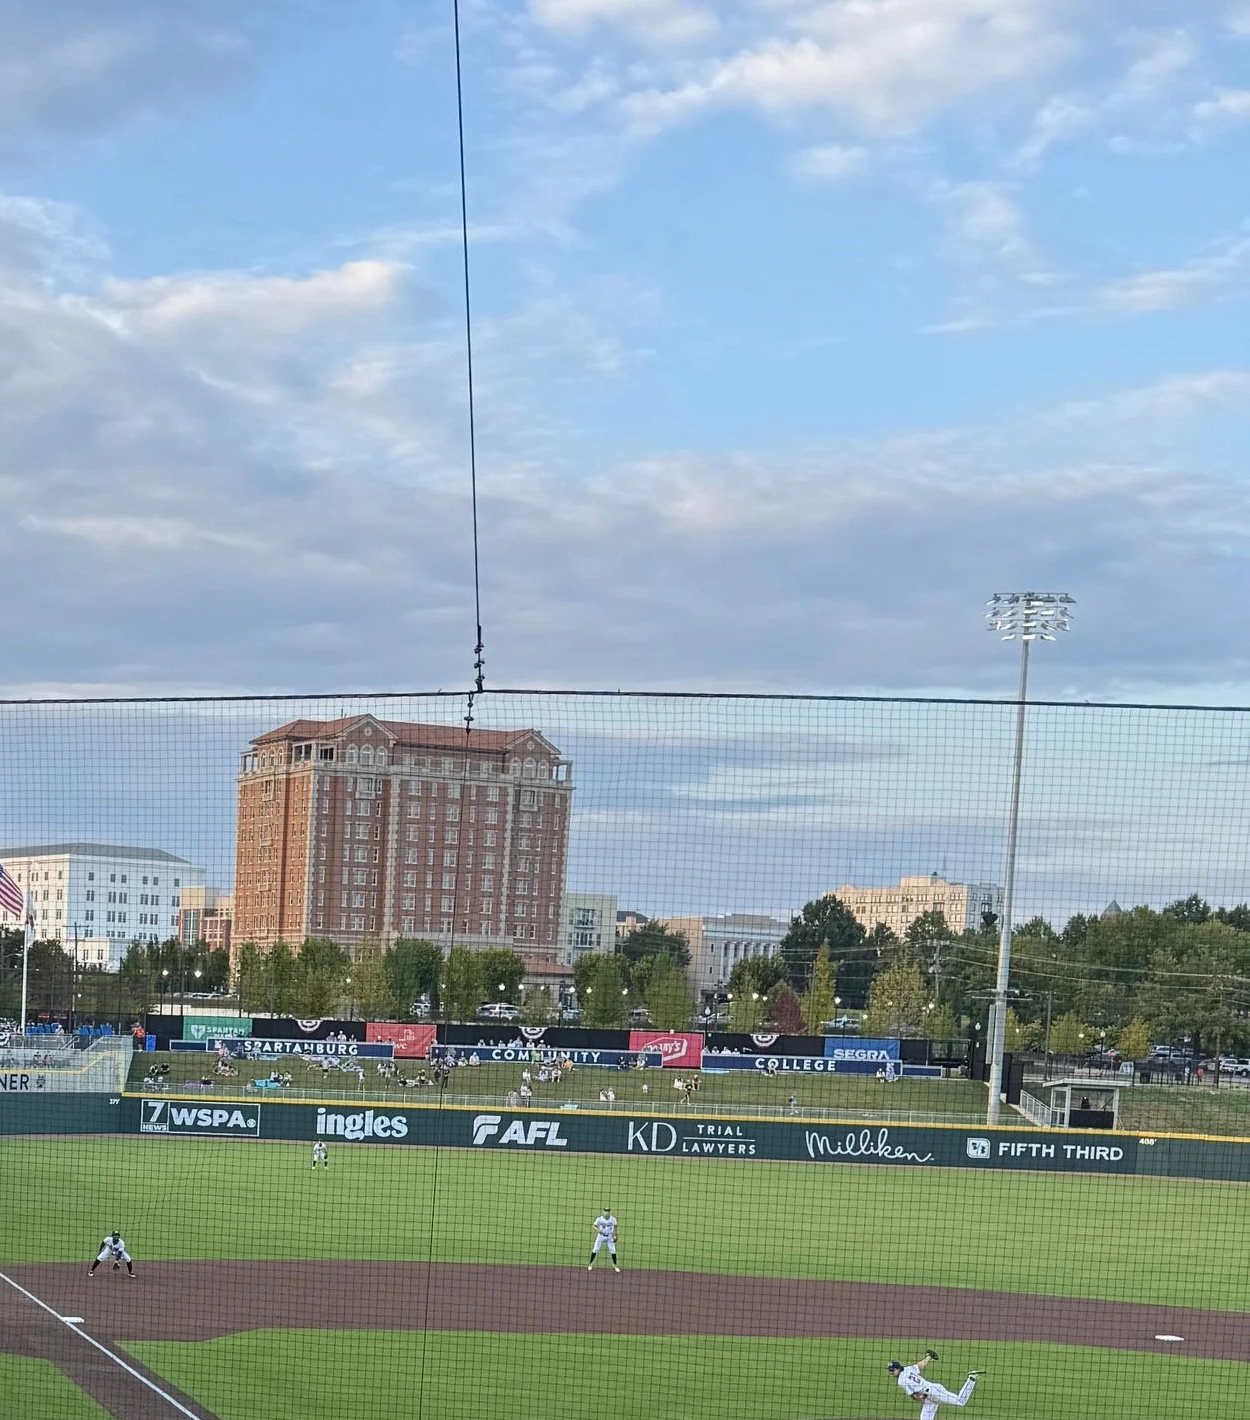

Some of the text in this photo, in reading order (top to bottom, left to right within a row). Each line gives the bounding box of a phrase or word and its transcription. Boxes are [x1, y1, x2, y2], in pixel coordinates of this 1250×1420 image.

[491, 1049, 601, 1062] COMUNITY
[755, 1058, 835, 1071] COLLEGE
[148, 1102, 165, 1122] 7
[170, 1107, 247, 1128] WSPA
[316, 1107, 409, 1141] ingles
[499, 1120, 568, 1146] AFL
[697, 1124, 743, 1136] TRIAL
[627, 1121, 678, 1152] KD
[805, 1128, 934, 1162] Milliken
[682, 1141, 756, 1155] LAWYERS
[998, 1143, 1124, 1161] FIFTH THIRD
